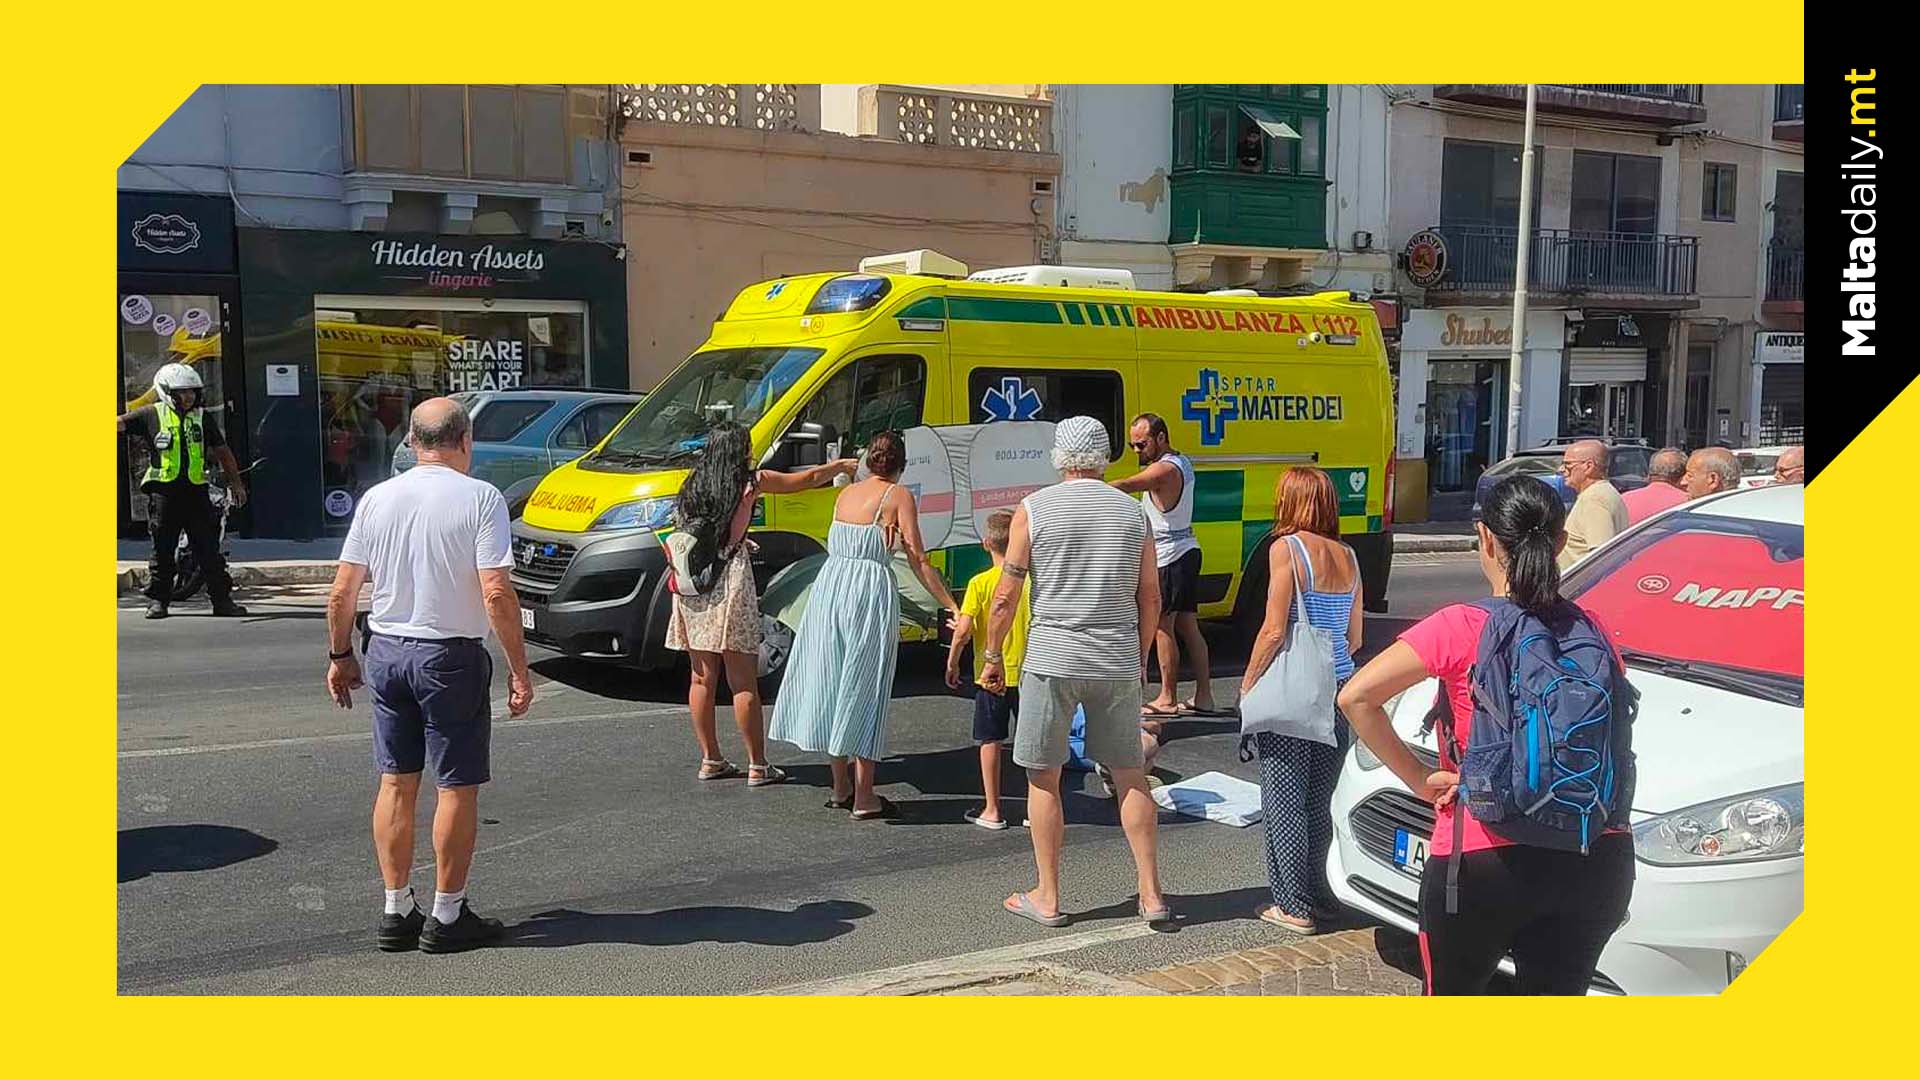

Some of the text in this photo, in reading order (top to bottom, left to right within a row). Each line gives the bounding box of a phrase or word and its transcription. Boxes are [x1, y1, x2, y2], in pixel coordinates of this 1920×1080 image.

[371, 240, 544, 271] Hidden Assets
[428, 270, 493, 290] lingerie
[1135, 305, 1362, 336] AMBULANZA 112
[1440, 312, 1529, 345] Shubet
[448, 340, 522, 361] SHARE
[497, 361, 522, 370] YOUR
[449, 371, 522, 392] HEART
[1242, 396, 1342, 420] MATER DEI
